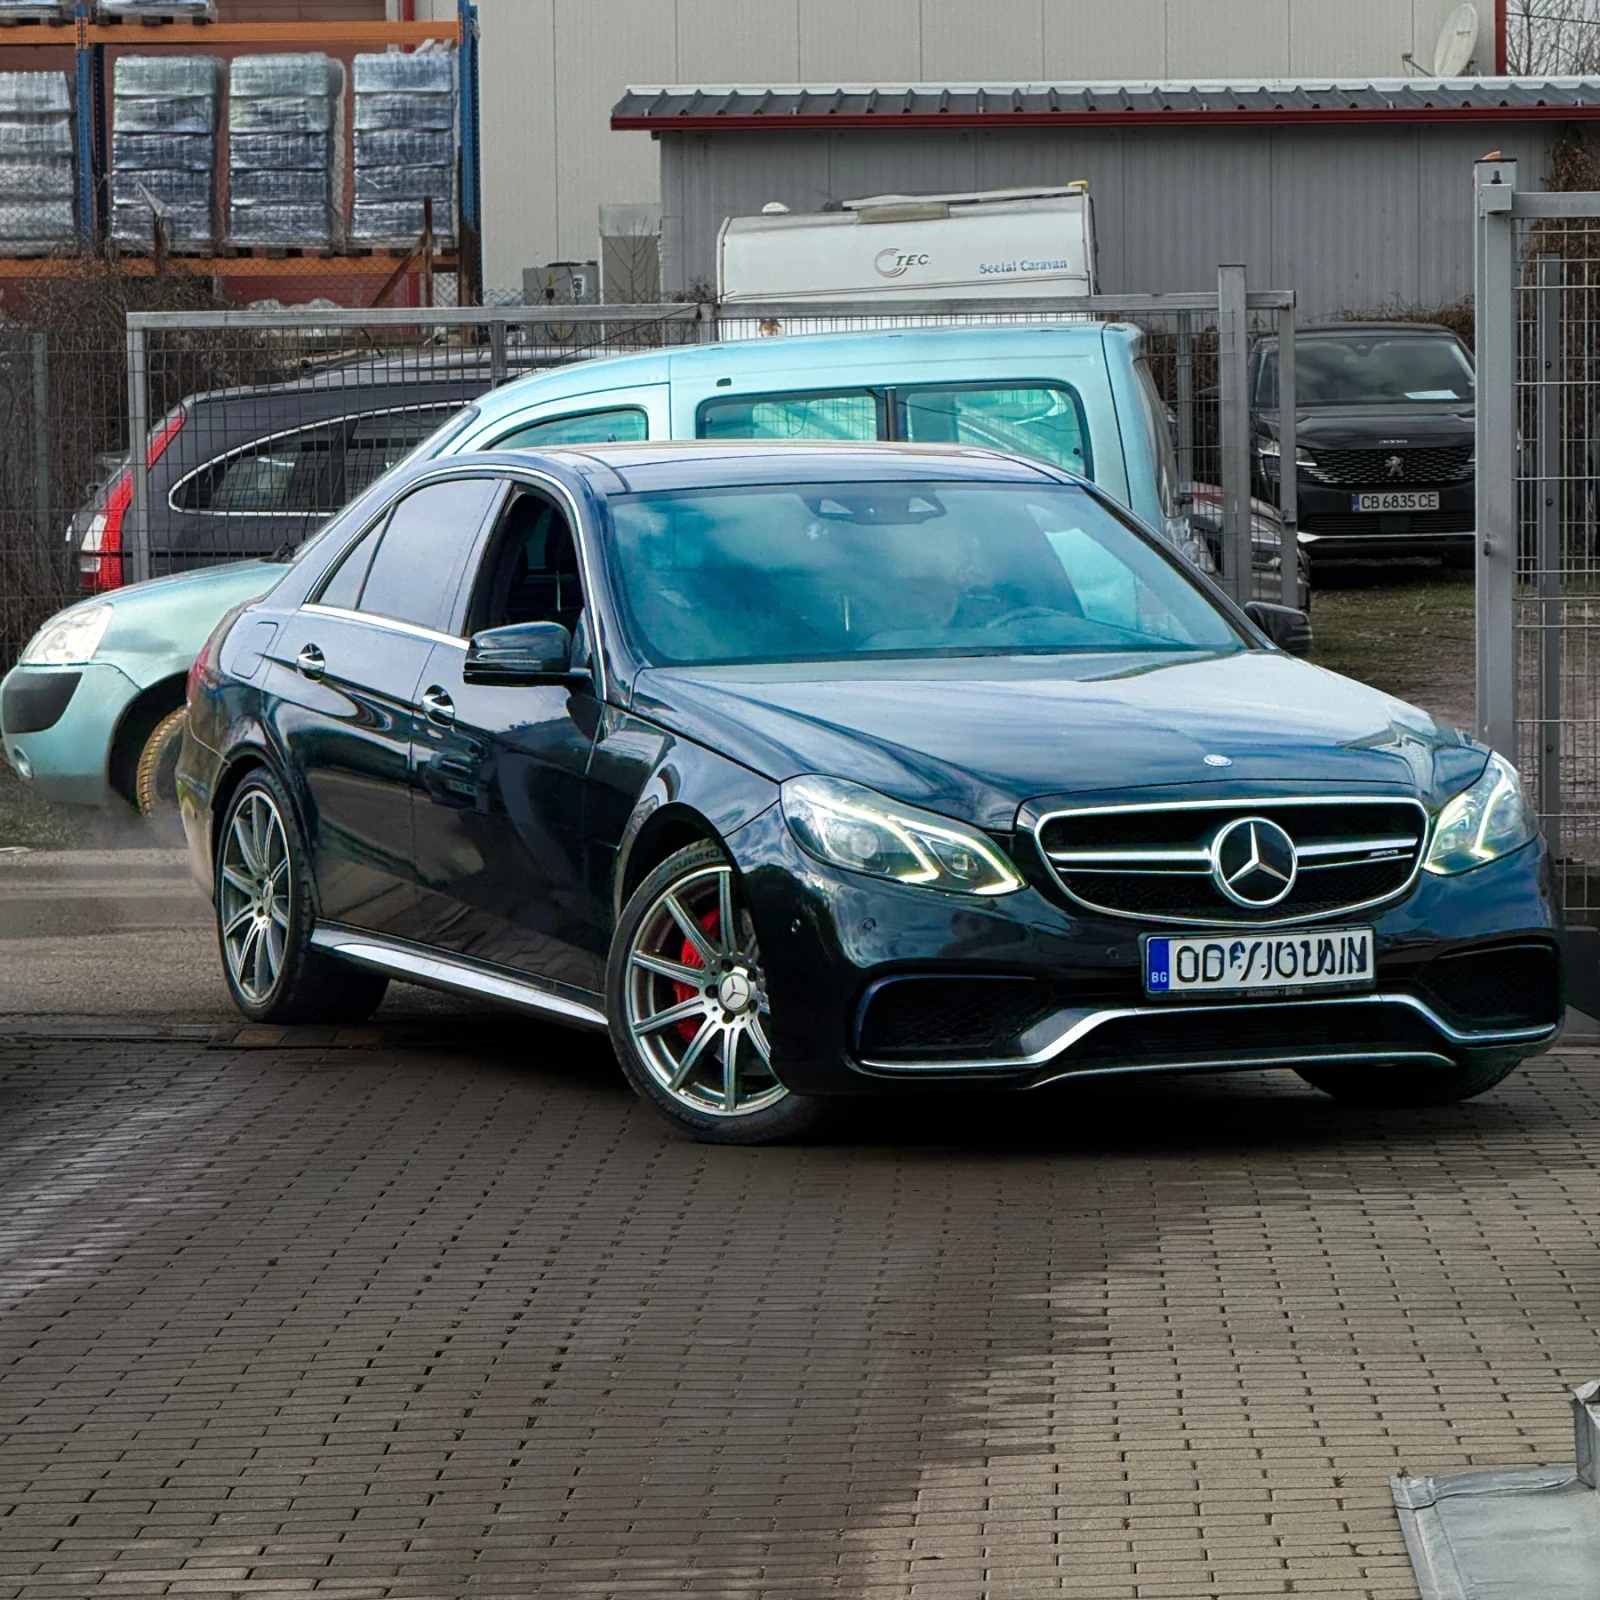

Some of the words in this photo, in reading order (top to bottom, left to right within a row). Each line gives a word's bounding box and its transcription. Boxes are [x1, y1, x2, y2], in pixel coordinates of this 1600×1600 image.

[1020, 259, 1068, 271] Caravan
[1361, 495, 1380, 509] CB
[1382, 494, 1416, 509] 6835
[1419, 494, 1437, 508] CE
[1151, 971, 1168, 983] BG
